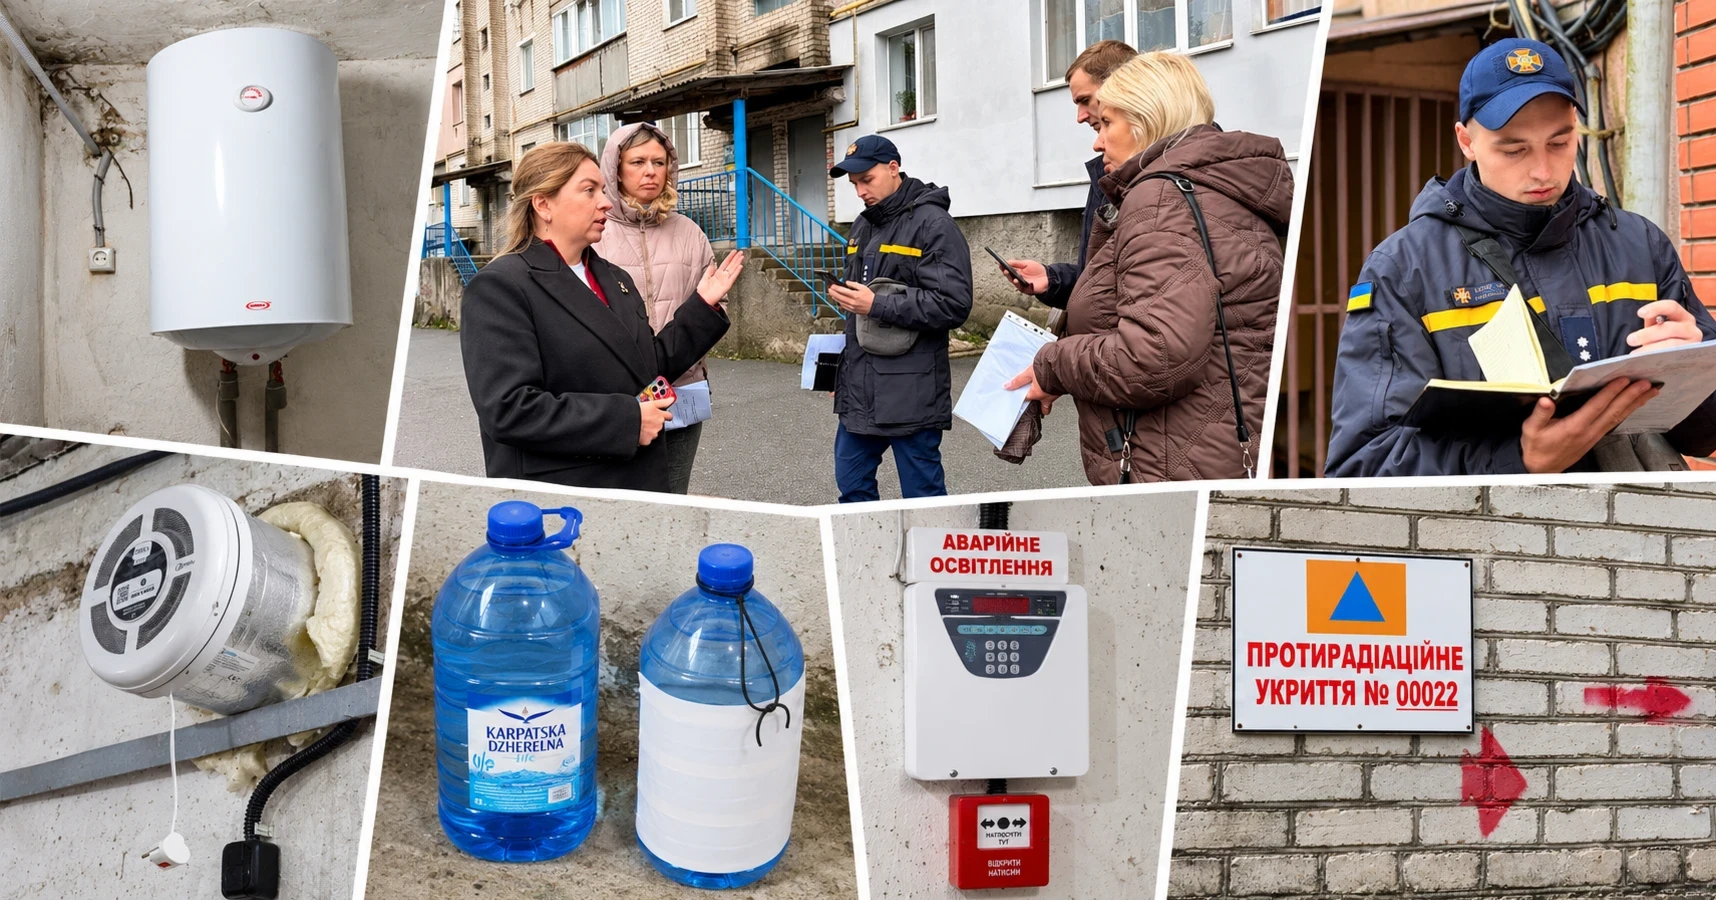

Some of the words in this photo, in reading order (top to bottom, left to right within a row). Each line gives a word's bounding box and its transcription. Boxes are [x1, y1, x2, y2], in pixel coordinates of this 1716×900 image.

[943, 533, 1040, 552] АВАРІЙНЕ
[930, 557, 1052, 576] ОСВІТЛЕННЯ
[1247, 640, 1464, 674] ПРОТИРАДІАЦІЙНЕ
[1256, 679, 1356, 706] УКРИТТЯ
[1364, 680, 1389, 706] №
[1396, 680, 1458, 707] 00022
[486, 724, 566, 740] KARPATSKA
[488, 738, 564, 753] DZHERELNA
